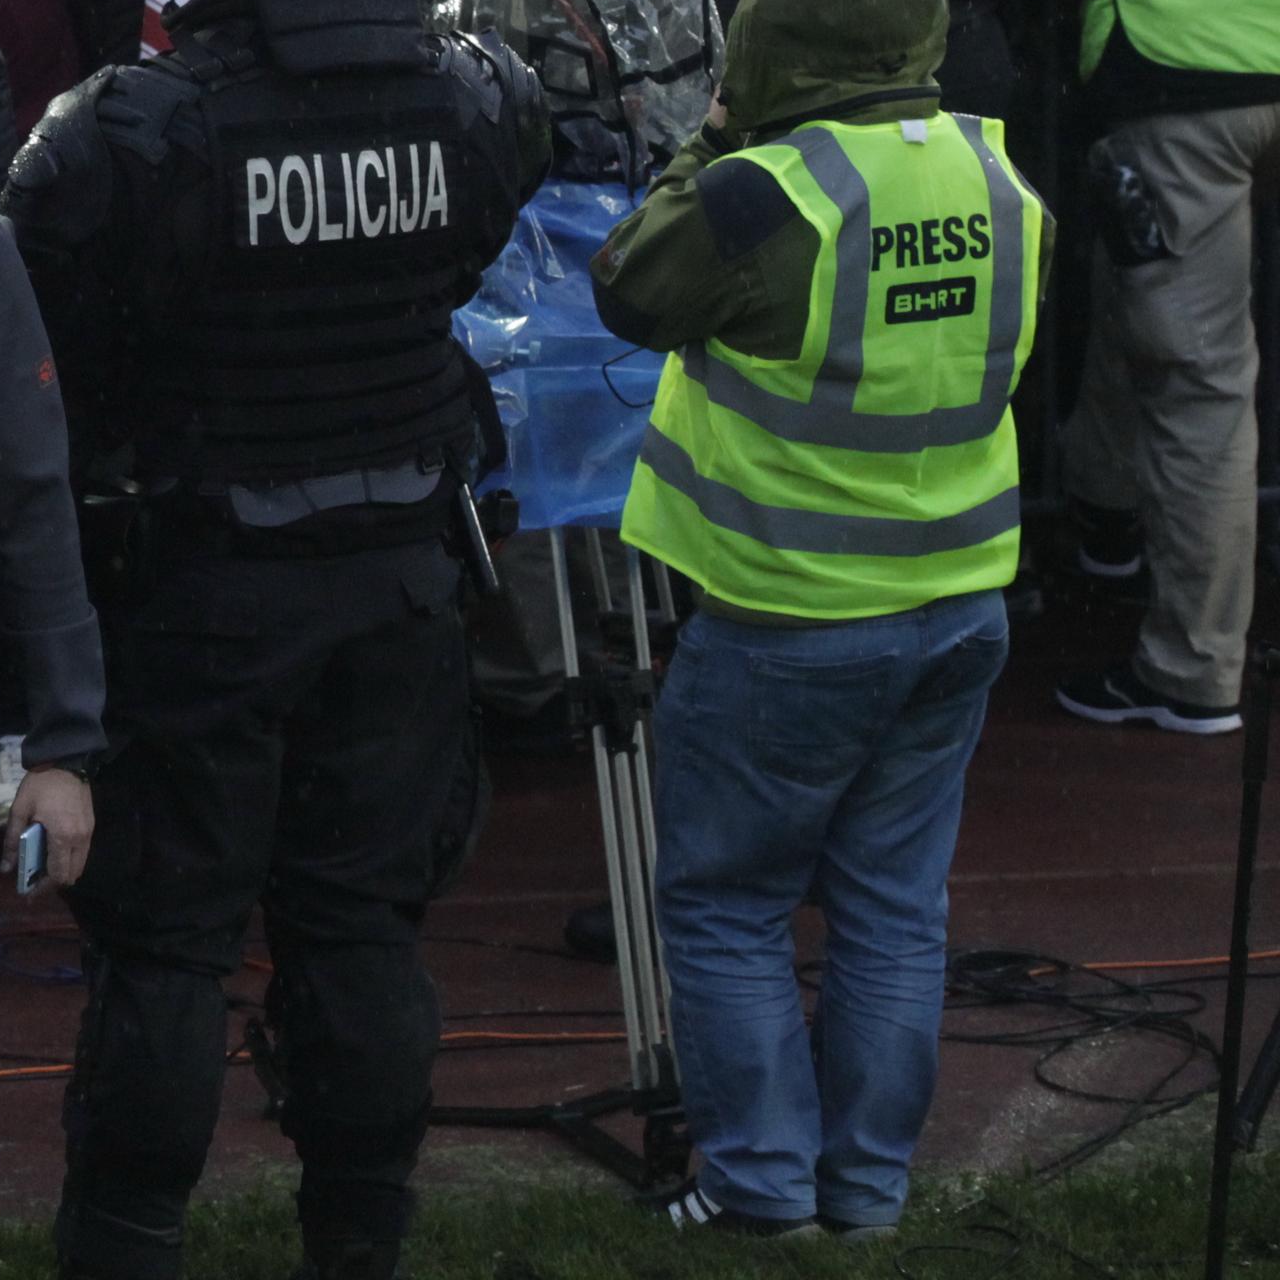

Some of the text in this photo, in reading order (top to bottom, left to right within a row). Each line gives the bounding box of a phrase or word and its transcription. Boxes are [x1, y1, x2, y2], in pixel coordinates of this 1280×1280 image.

[246, 140, 448, 246] POLICIJA
[871, 213, 990, 272] PRESS
[894, 287, 967, 313] BHRT
